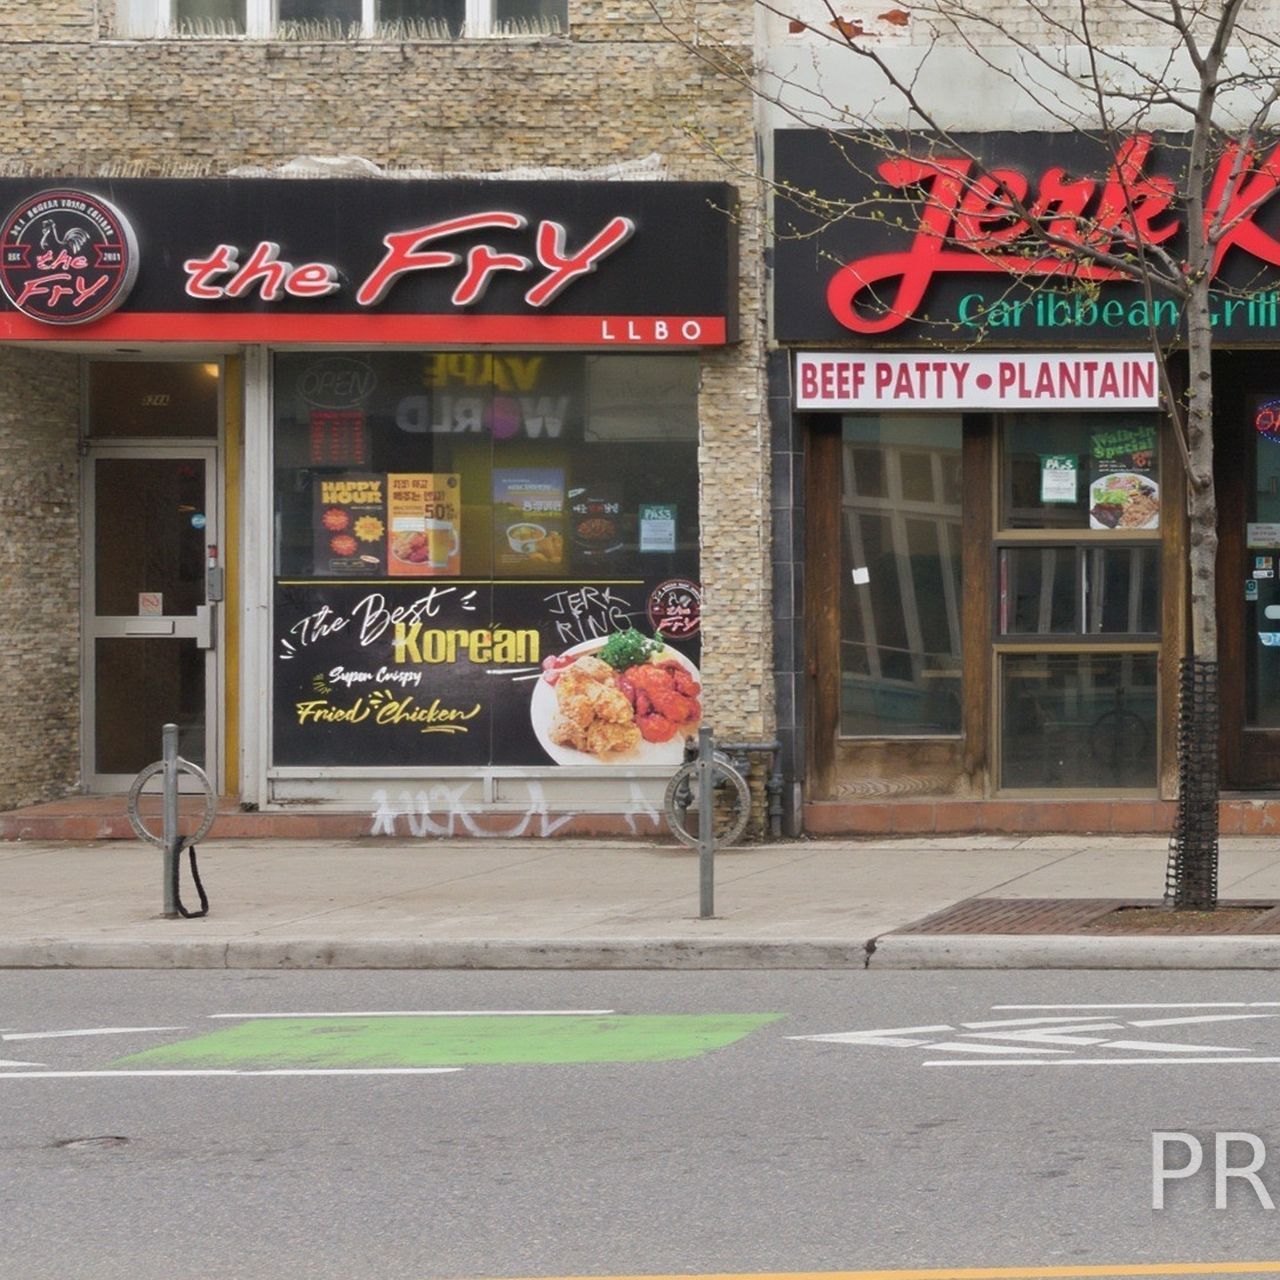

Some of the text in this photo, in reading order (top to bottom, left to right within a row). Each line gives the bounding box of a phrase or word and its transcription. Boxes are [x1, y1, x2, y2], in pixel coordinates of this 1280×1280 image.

[827, 133, 1190, 334] Jerk
[36, 249, 89, 270] the
[184, 241, 342, 301] the
[958, 292, 1178, 328] Caribbean
[601, 319, 702, 341] LLBO
[301, 372, 370, 396] OPEN
[801, 360, 1155, 400] BEEF PATTY PLANTAIN
[321, 481, 381, 492] HAPPY
[321, 491, 382, 504] HOUR
[543, 586, 631, 614] JERK
[290, 586, 457, 647] The Best
[393, 622, 540, 664] Korean
[328, 666, 423, 688] Super Crispy
[296, 696, 481, 725] Fried Chicken
